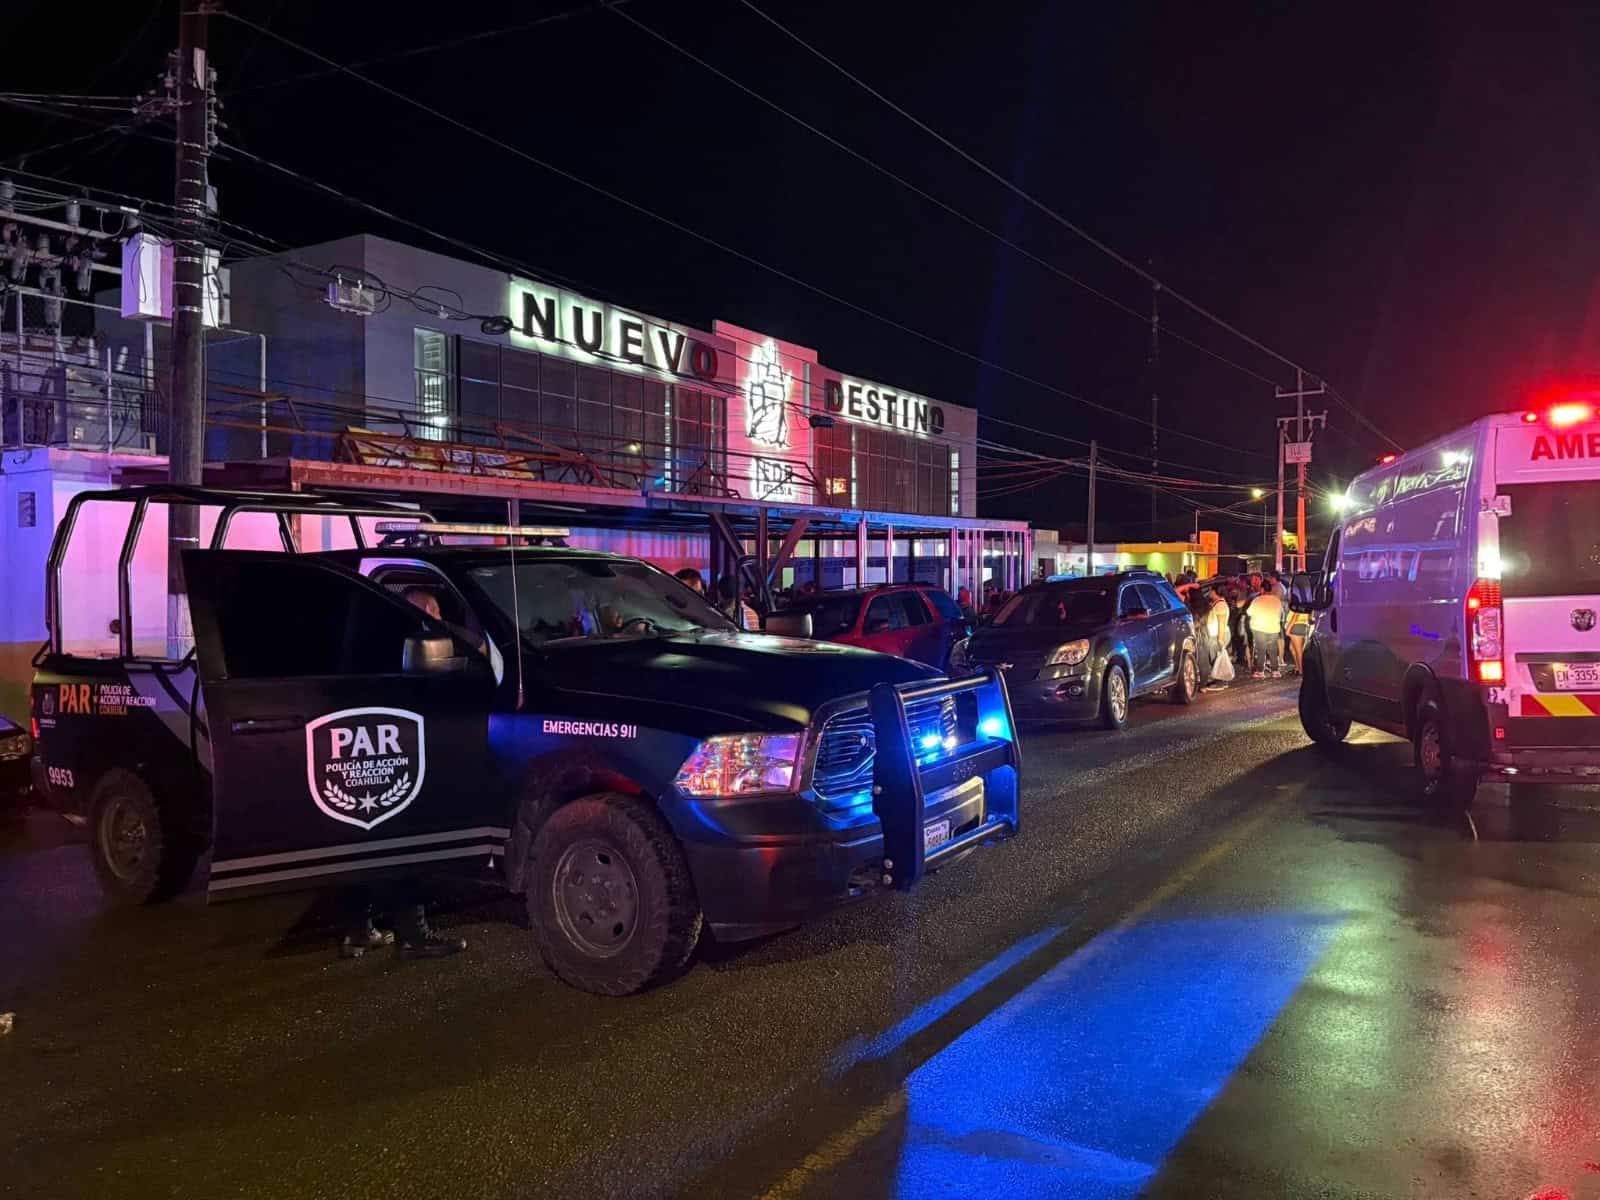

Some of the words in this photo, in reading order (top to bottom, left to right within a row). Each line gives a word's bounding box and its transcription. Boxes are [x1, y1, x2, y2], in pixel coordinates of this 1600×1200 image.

[522, 291, 719, 379] NUEVO
[824, 379, 944, 435] DESTINO
[60, 684, 91, 715] PAR
[122, 685, 131, 695] DE
[543, 720, 618, 737] EMERGENCIAS
[620, 724, 637, 738] 911
[329, 724, 402, 759] PAR
[362, 760, 375, 769] DE
[48, 766, 74, 787] 9953
[341, 771, 349, 780] Y
[345, 776, 391, 788] COAHUILA
